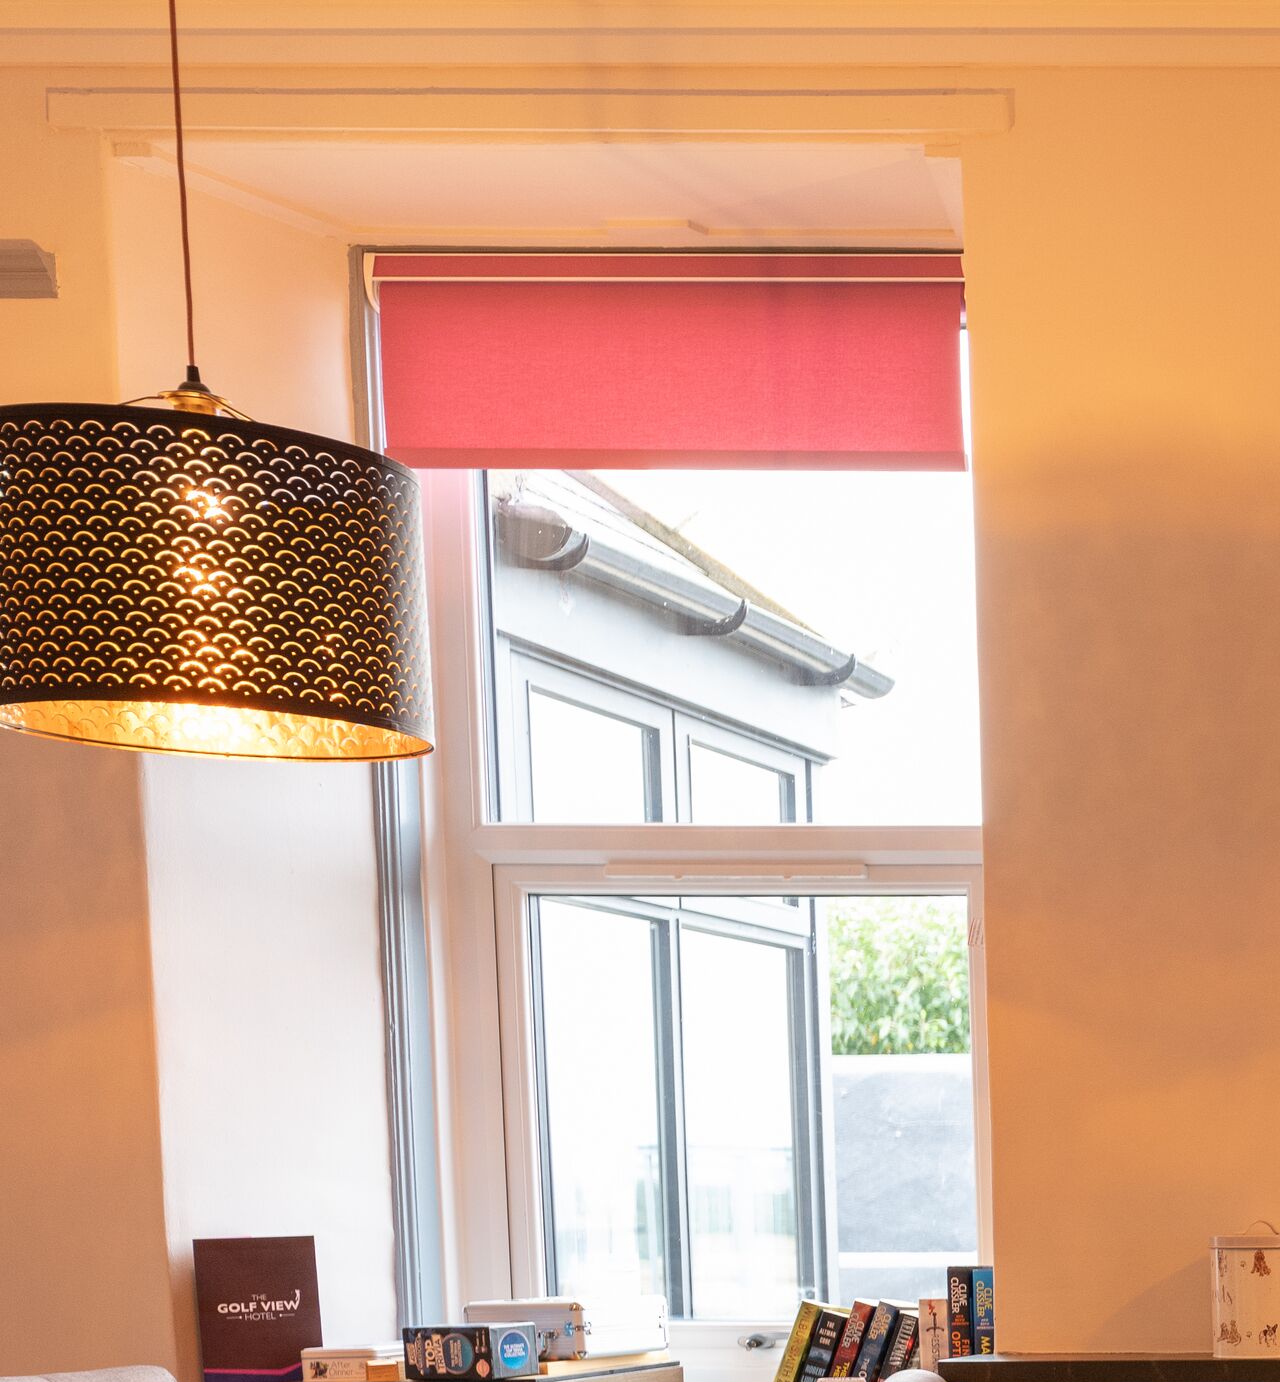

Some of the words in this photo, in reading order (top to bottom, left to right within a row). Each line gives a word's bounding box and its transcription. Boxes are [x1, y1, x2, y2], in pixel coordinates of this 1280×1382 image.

[217, 1301, 257, 1314] GOLF
[261, 1300, 300, 1312] VIEW
[951, 1276, 960, 1314] CUSSLER
[959, 1283, 967, 1307] CLIVE
[976, 1280, 985, 1318] CUSSLER
[984, 1287, 993, 1311] CLIVE
[244, 1312, 276, 1321] HOTEL
[794, 1306, 813, 1346] WILBUR
[868, 1305, 886, 1340] CUSSLER
[879, 1313, 892, 1337] CLIVE
[819, 1327, 836, 1339] ALTMAN
[819, 1336, 831, 1346] CODE
[841, 1312, 859, 1348] CUSSLER
[852, 1320, 864, 1344] CLIVE
[425, 1339, 436, 1369] TOP
[434, 1338, 444, 1370] TRIVIA
[952, 1331, 961, 1357] OPTI
[962, 1339, 970, 1356] FIN
[331, 1360, 350, 1369] After
[782, 1345, 799, 1377] SMITH
